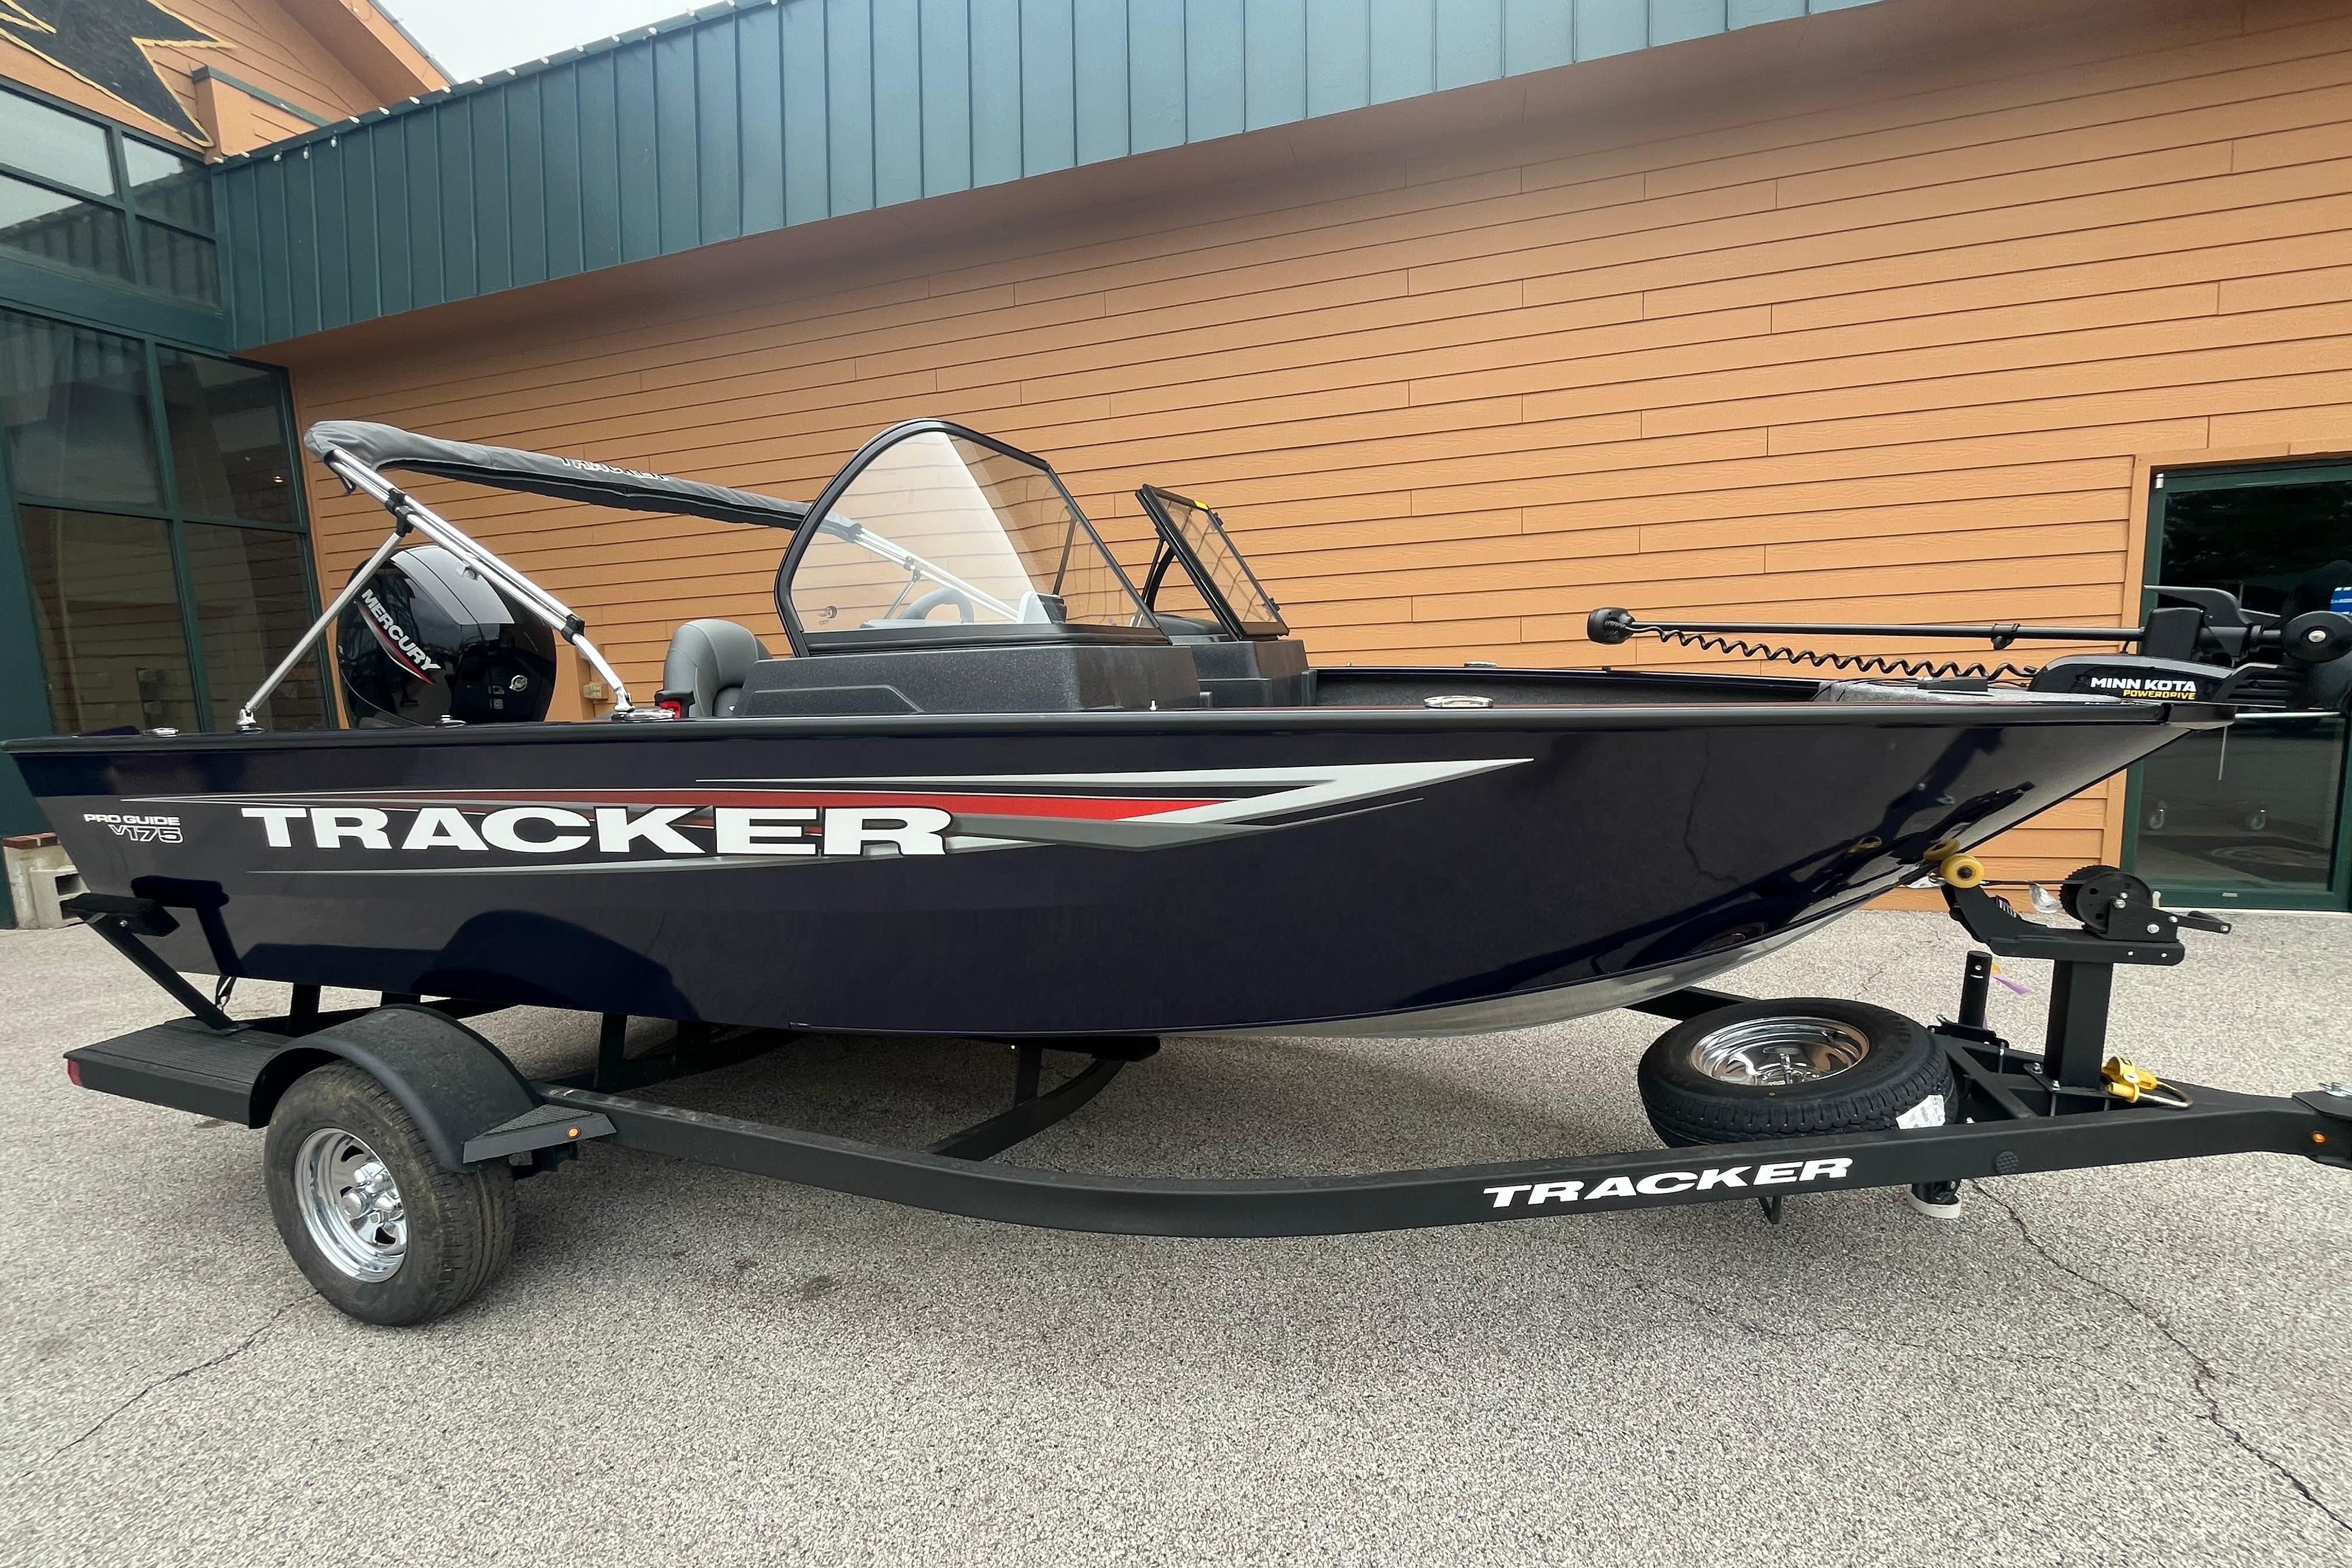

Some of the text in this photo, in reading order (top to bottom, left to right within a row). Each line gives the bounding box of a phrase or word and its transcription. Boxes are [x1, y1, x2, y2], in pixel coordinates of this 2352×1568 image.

[362, 589, 441, 670] MERCURY
[2091, 677, 2197, 692] MINN KOTA
[2123, 690, 2196, 699] POWERDRIVE
[83, 814, 181, 826] PRO GUIDE
[108, 824, 184, 844] V175
[242, 807, 947, 855] TRACKER
[1483, 1157, 1854, 1208] TRACKER
